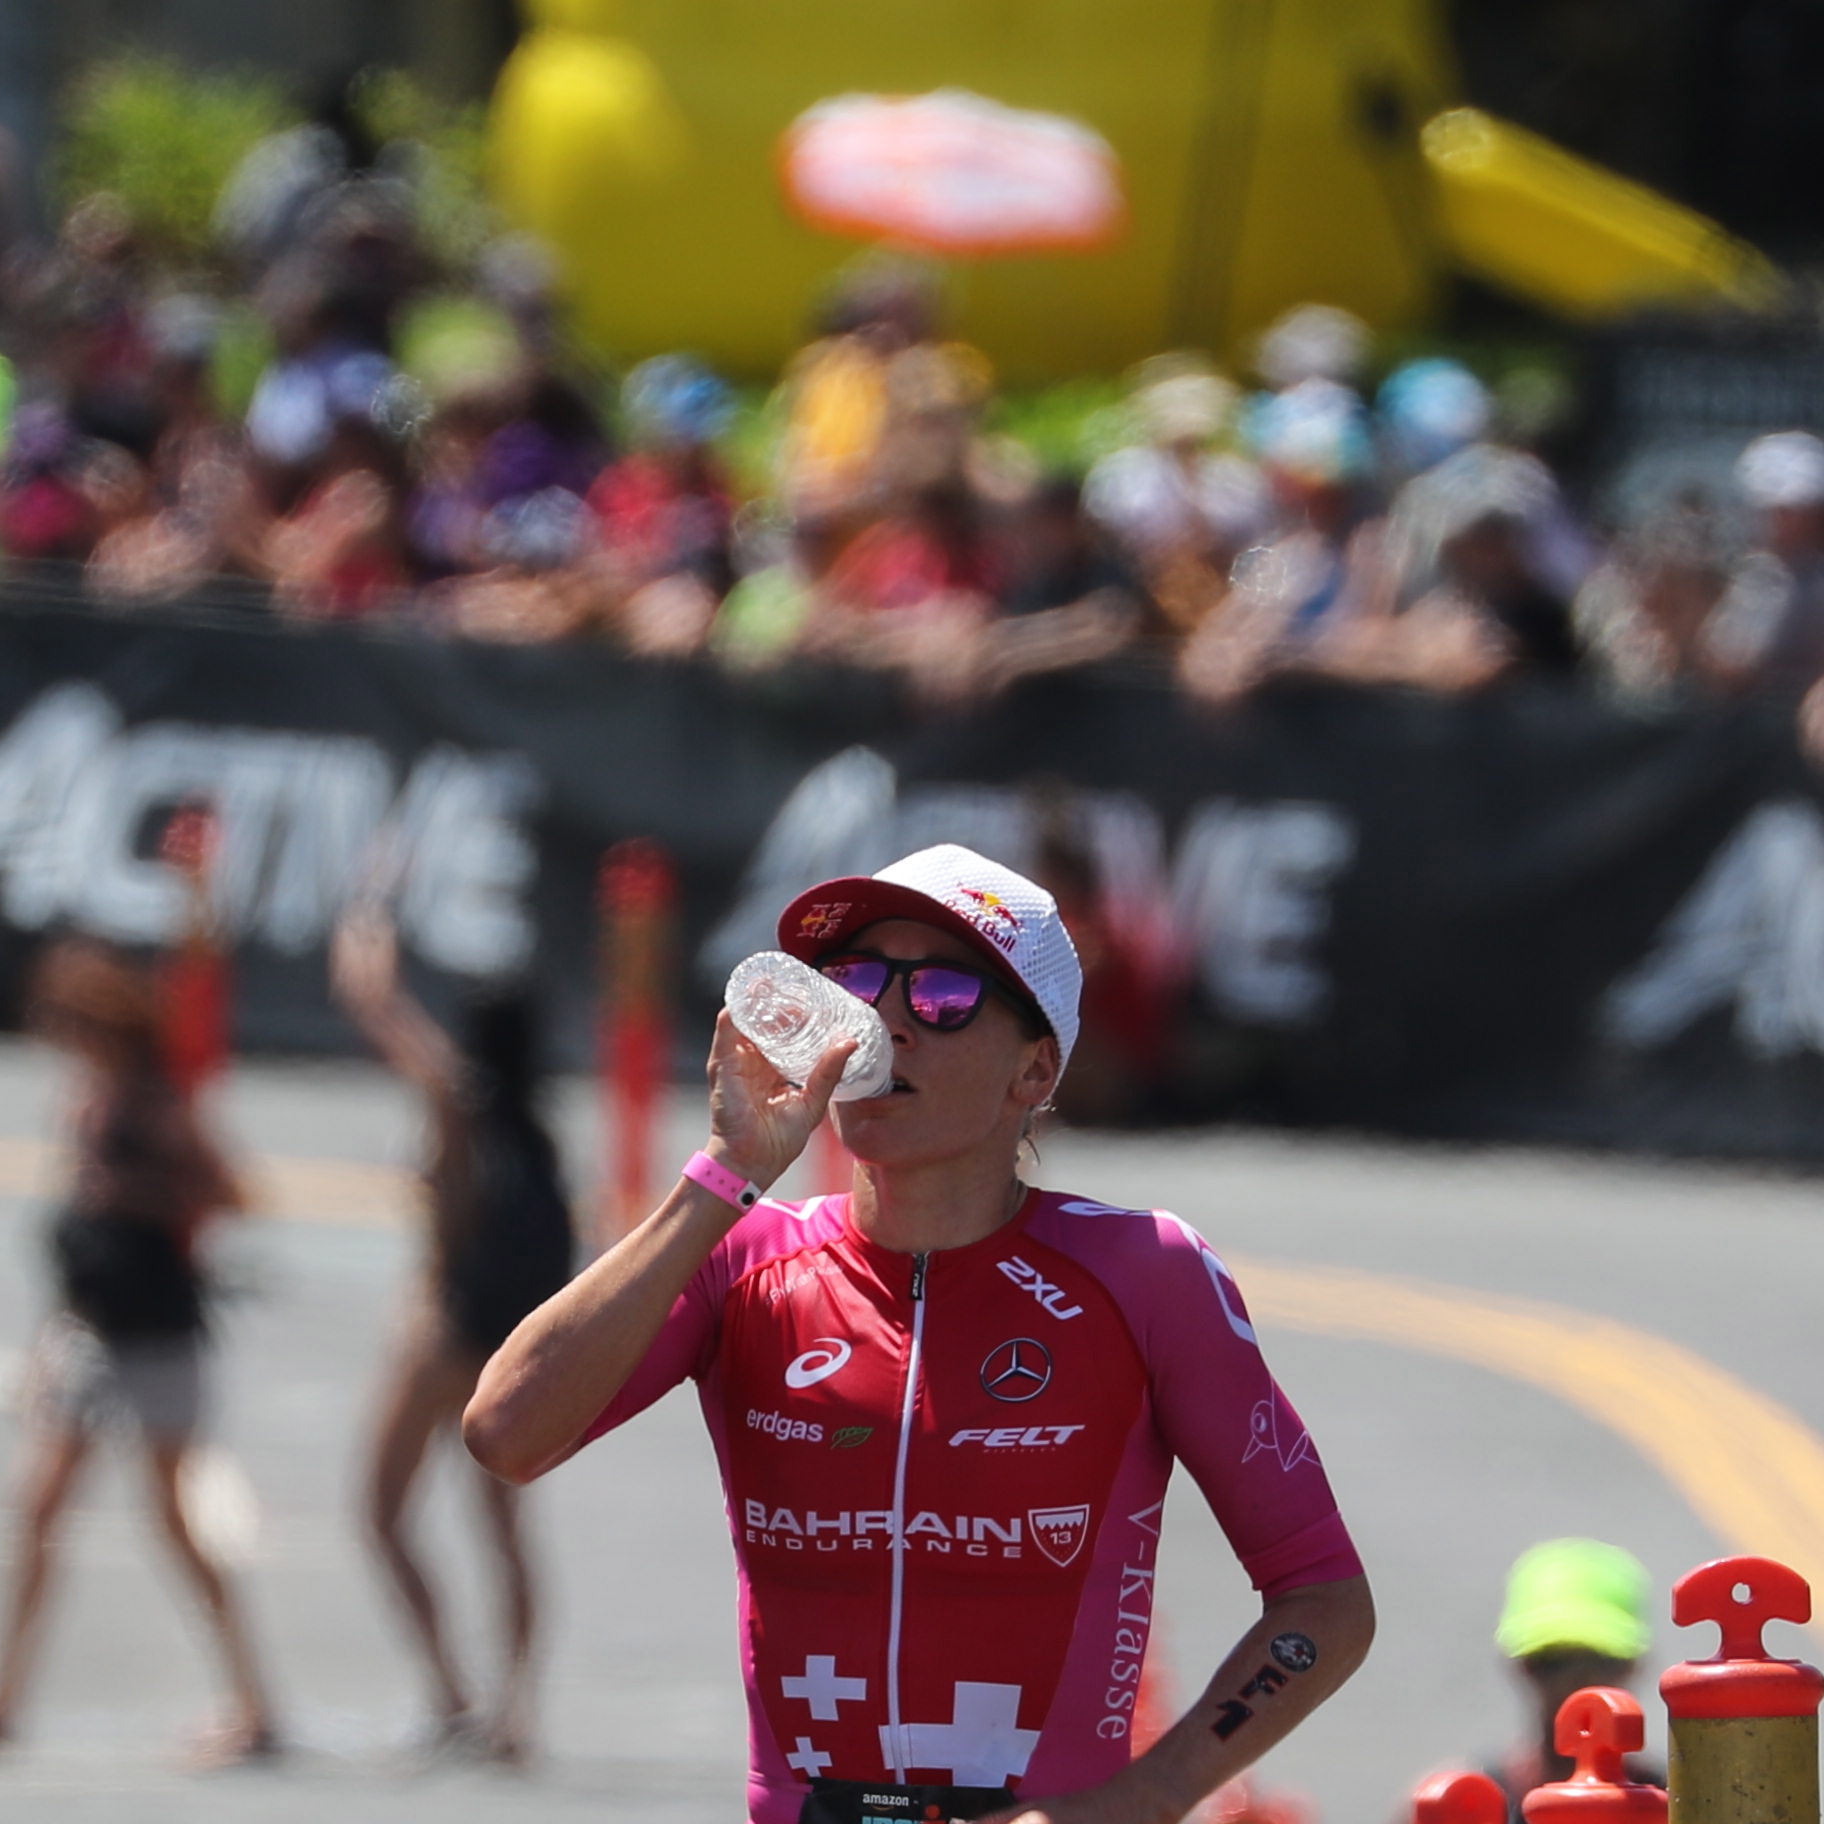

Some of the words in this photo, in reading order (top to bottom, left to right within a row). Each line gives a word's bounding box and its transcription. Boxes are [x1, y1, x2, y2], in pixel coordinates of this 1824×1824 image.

[982, 920, 1016, 953] Bull
[996, 1256, 1083, 1320] 2XU
[746, 1409, 824, 1442] erdgas
[948, 1424, 1085, 1447] FELT
[746, 1498, 1022, 1543] BAHRAIN
[746, 1530, 1022, 1558] ENDURANCE
[1049, 1531, 1072, 1545] 13
[1096, 1500, 1163, 1740] V-Klasse
[862, 1793, 910, 1807] amazon
